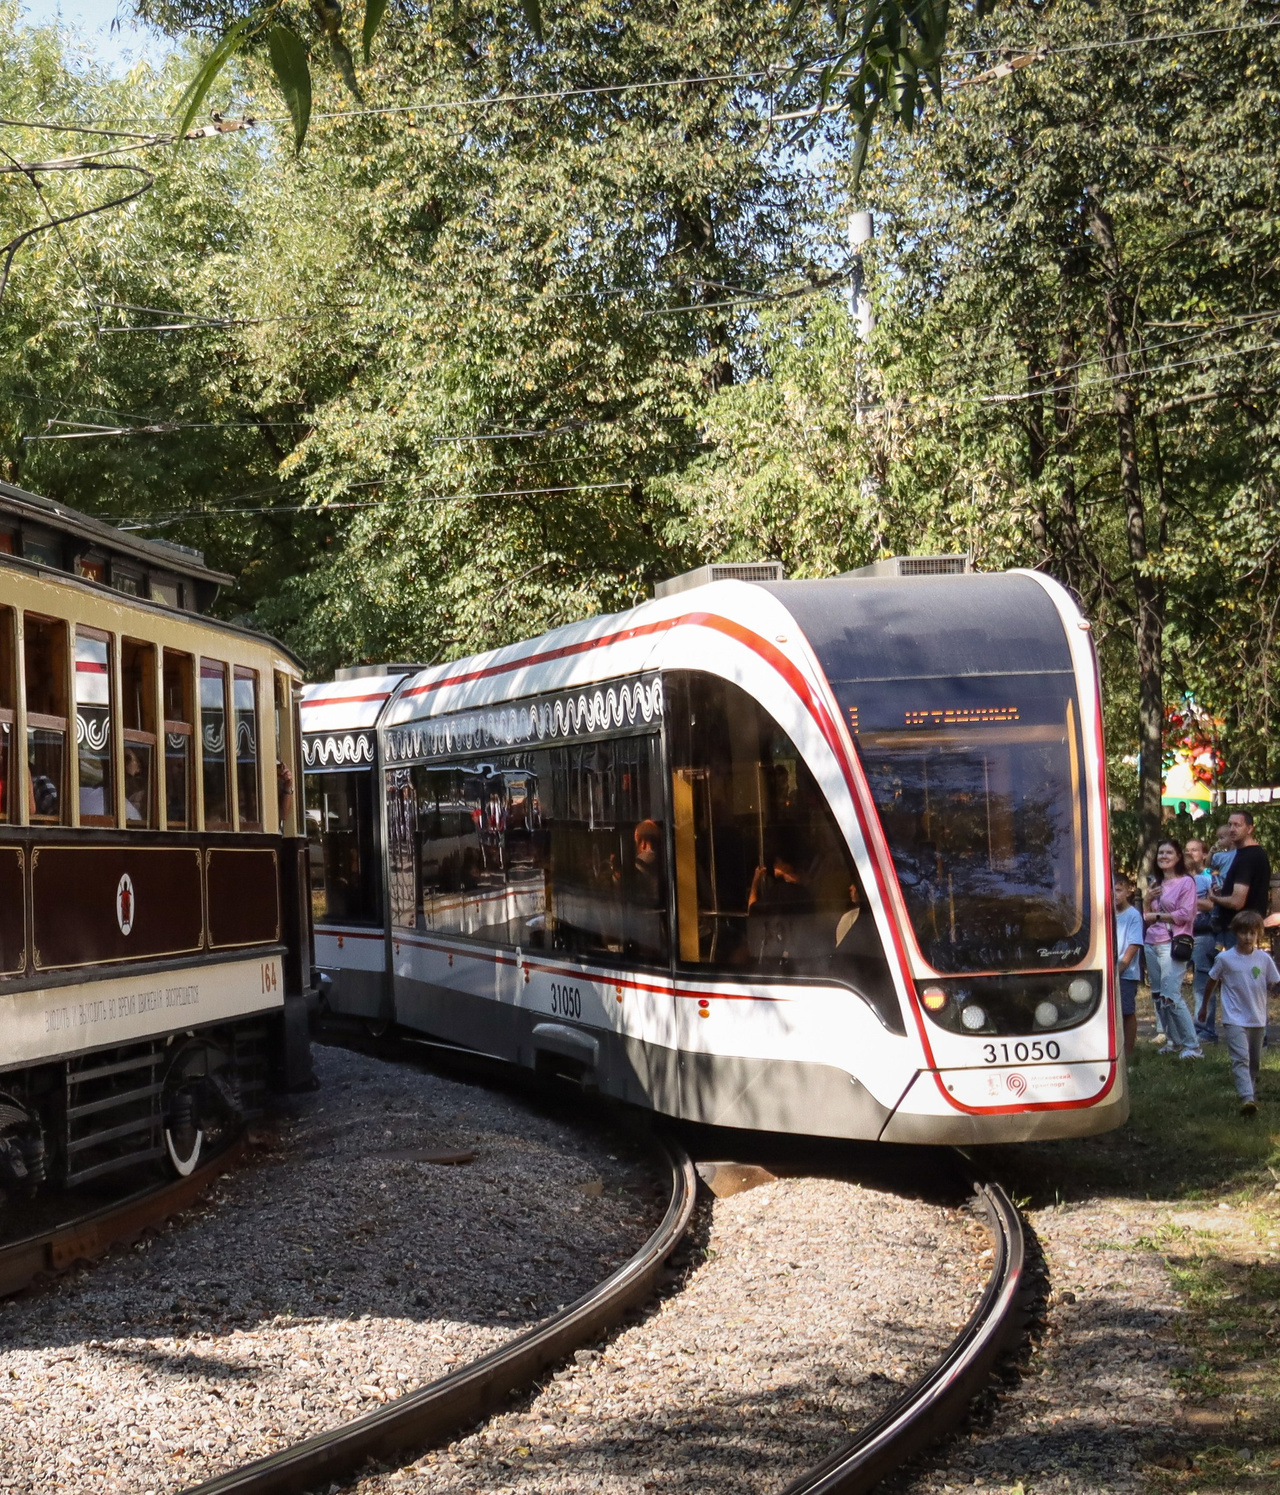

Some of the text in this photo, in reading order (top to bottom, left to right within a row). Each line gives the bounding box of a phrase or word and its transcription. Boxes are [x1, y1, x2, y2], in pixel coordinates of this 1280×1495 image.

[261, 962, 277, 994] 164
[551, 983, 581, 1019] 31050
[983, 1040, 1061, 1064] 31050
